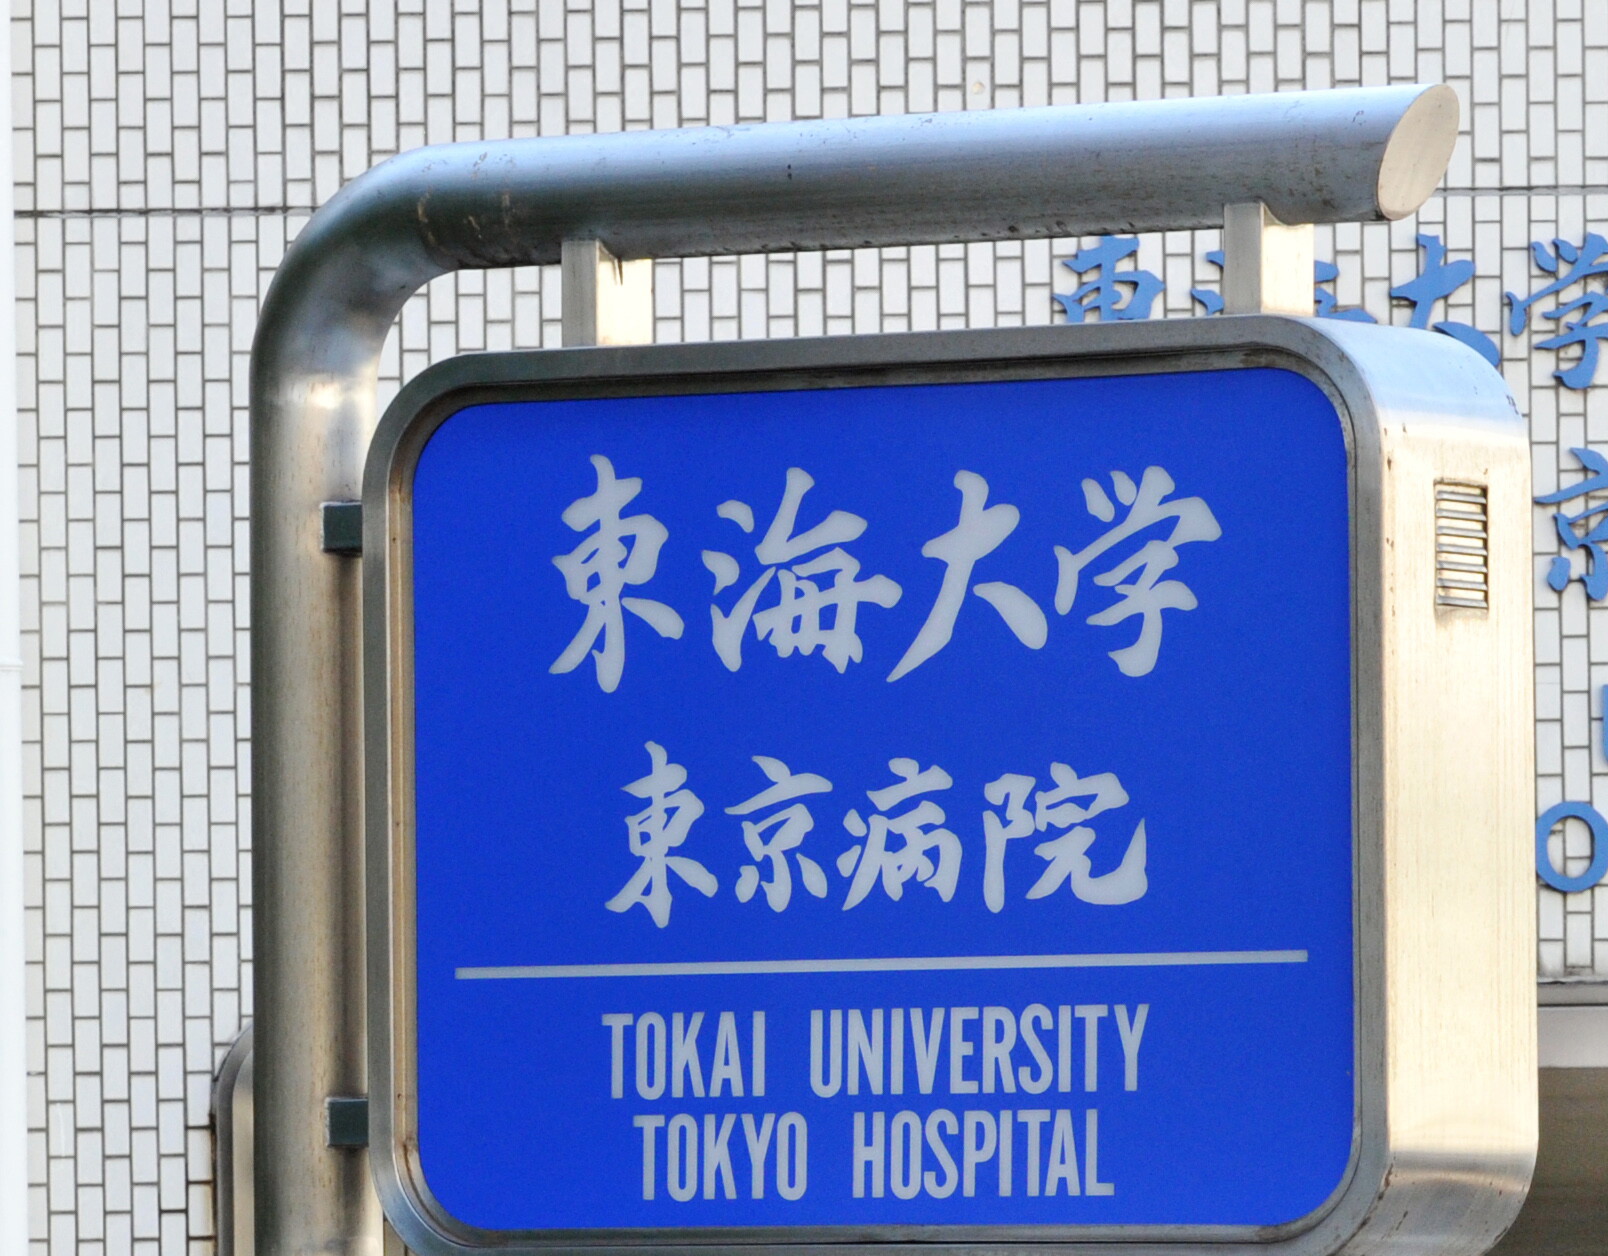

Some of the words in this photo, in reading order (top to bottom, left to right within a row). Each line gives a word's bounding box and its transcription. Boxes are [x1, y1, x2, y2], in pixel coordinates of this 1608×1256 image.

[549, 454, 1222, 693] 東海大学
[605, 741, 1148, 928] 東京病院
[602, 1010, 767, 1100] TOKAI
[809, 1003, 1150, 1098] UNIVERSITY
[633, 1111, 809, 1203] TOKYO
[852, 1108, 1115, 1200] HOSPITAL
